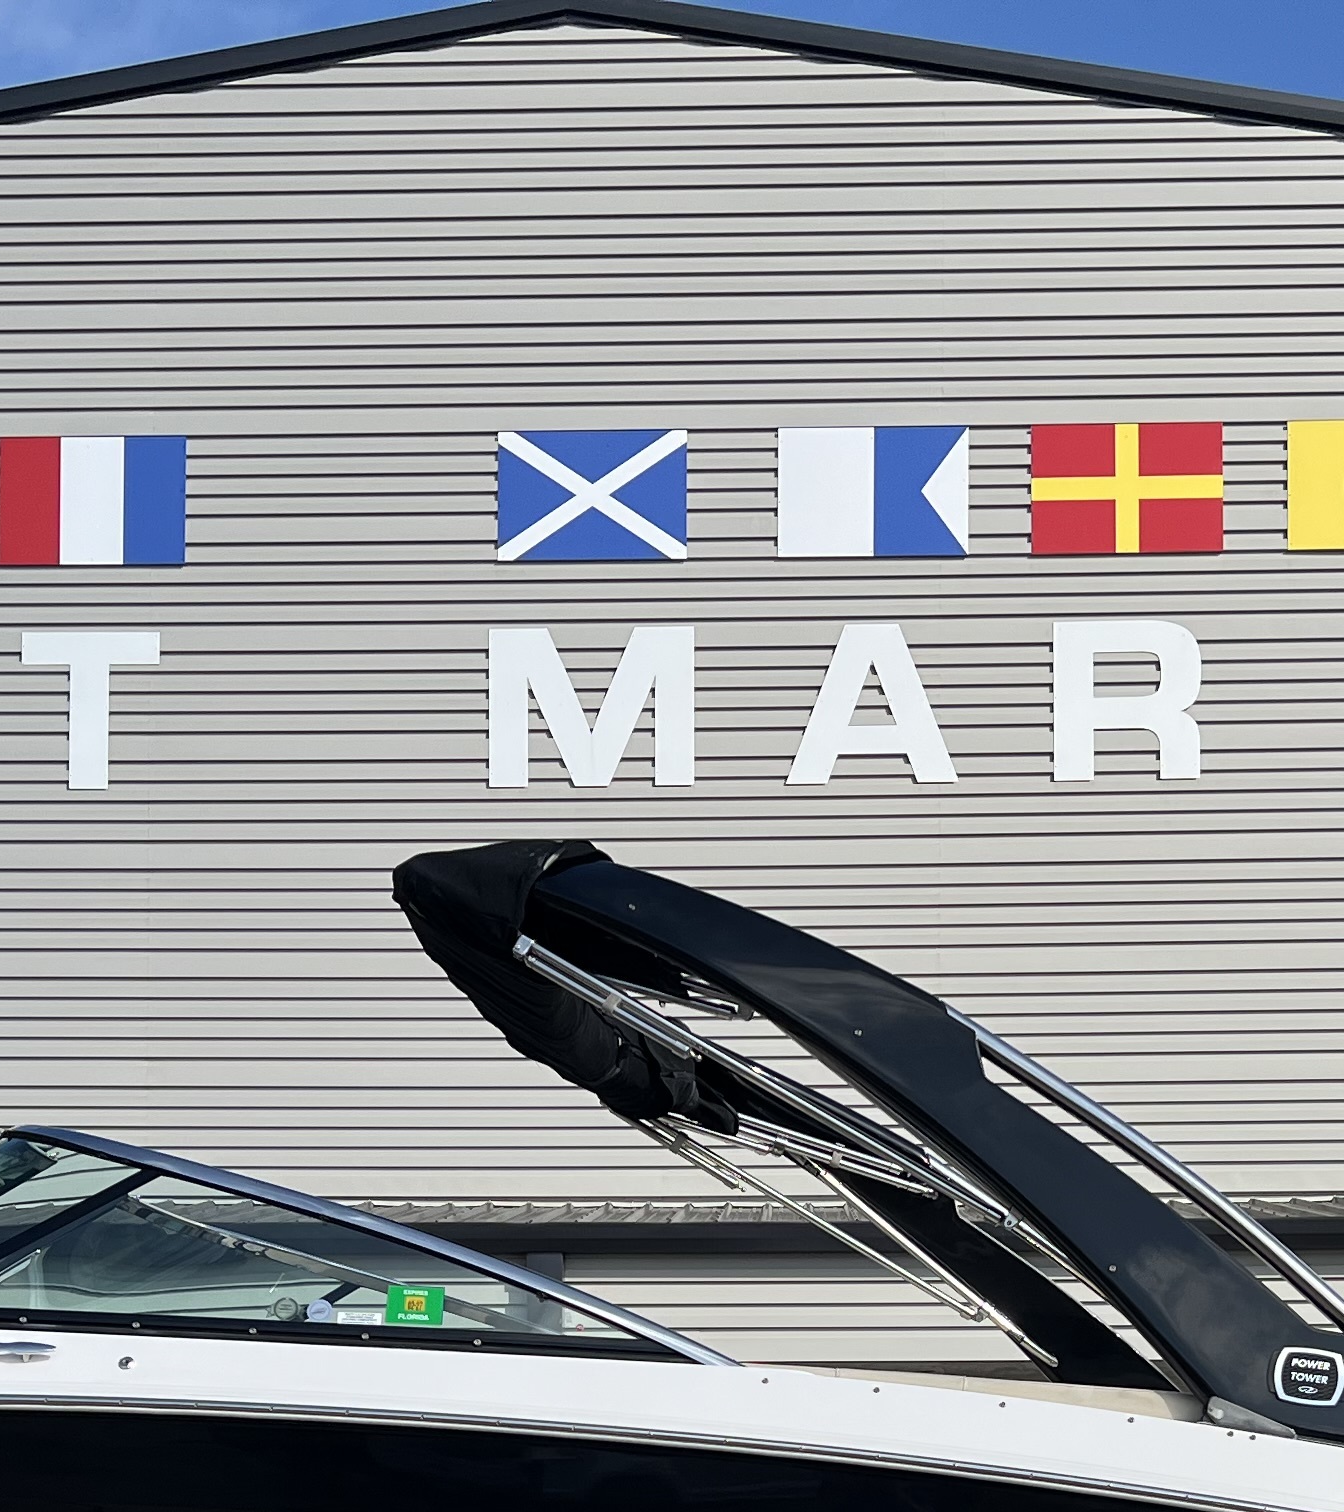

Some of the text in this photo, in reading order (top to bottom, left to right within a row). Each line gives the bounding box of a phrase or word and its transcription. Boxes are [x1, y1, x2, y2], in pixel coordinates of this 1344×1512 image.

[397, 1312, 430, 1321] FLORIDA
[1291, 1357, 1331, 1371] POWER
[1290, 1371, 1329, 1385] TOWER
